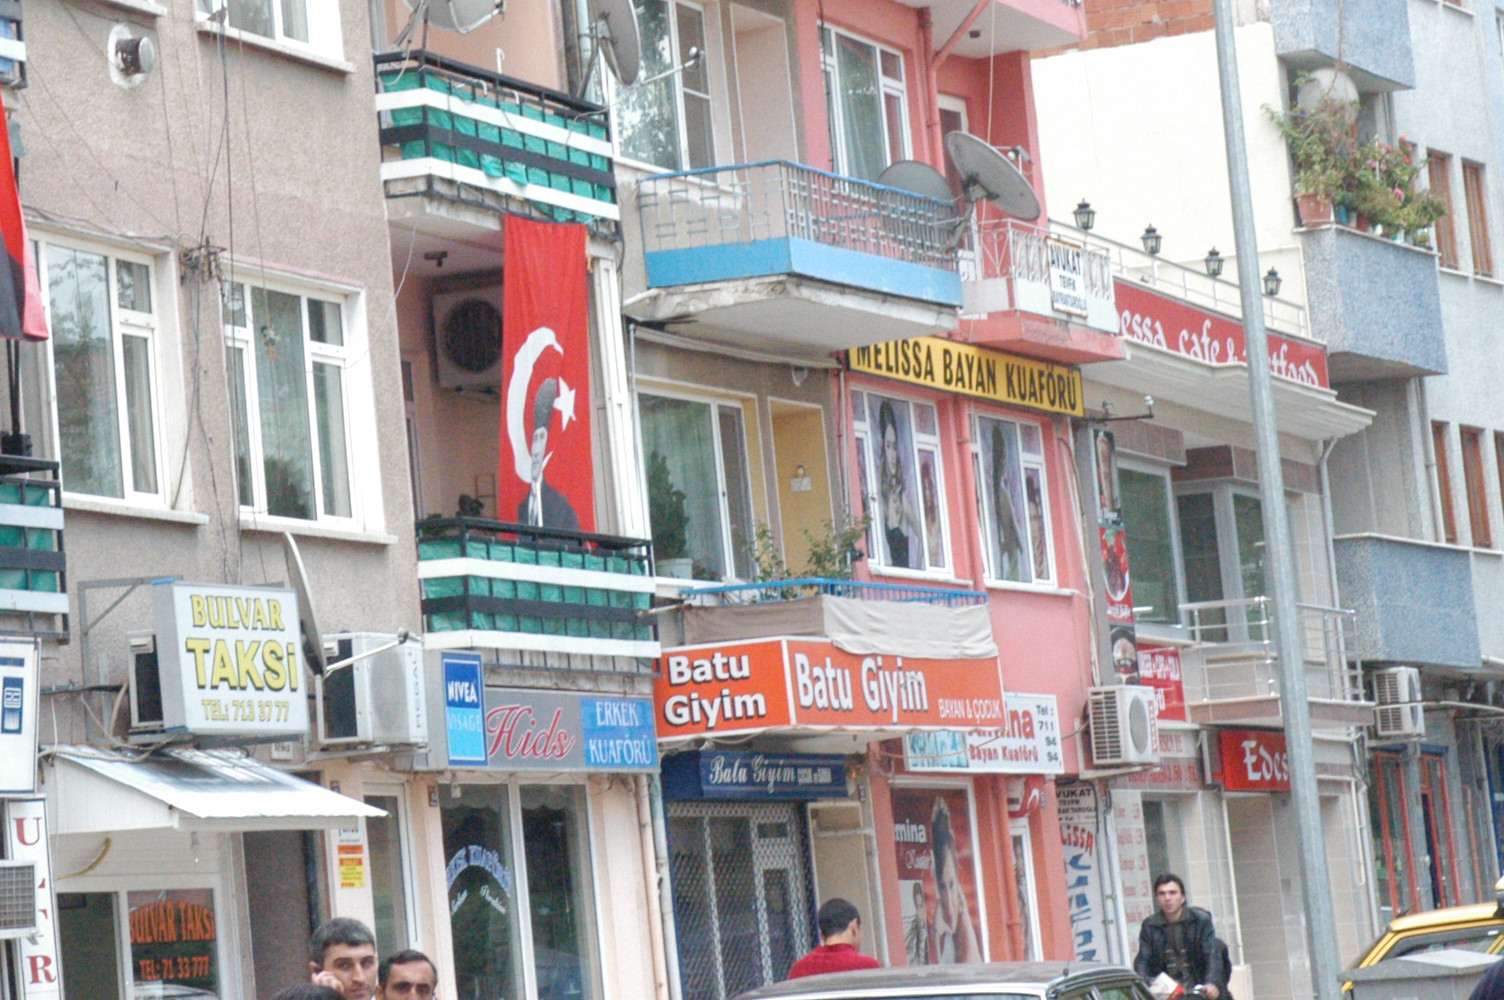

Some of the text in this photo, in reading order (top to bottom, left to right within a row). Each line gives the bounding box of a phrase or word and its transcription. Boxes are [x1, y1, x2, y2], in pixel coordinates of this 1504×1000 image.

[1120, 310, 1168, 350] essa
[943, 349, 996, 394] BAYAN
[1005, 363, 1077, 411] KUAFÖRÜ
[190, 594, 285, 631] BULVAR
[668, 652, 751, 685] Batu
[448, 681, 478, 703] NIVEA
[794, 652, 854, 710] Batu
[862, 656, 928, 724] Giyim
[202, 699, 229, 721] TEL:
[258, 701, 273, 722] 37
[275, 701, 289, 722] 77
[597, 701, 639, 727] ERKEK
[664, 688, 767, 728] Giyim
[938, 699, 966, 718] BAYAN
[973, 699, 1002, 723] ÇOCUK
[589, 733, 652, 765] KUAFÖRÜ
[970, 744, 1038, 763] Bayan Kuaförü
[1241, 740, 1289, 782] Edes
[752, 755, 796, 793] Giyim
[1056, 788, 1094, 798] VUKAT
[894, 818, 927, 843] mina
